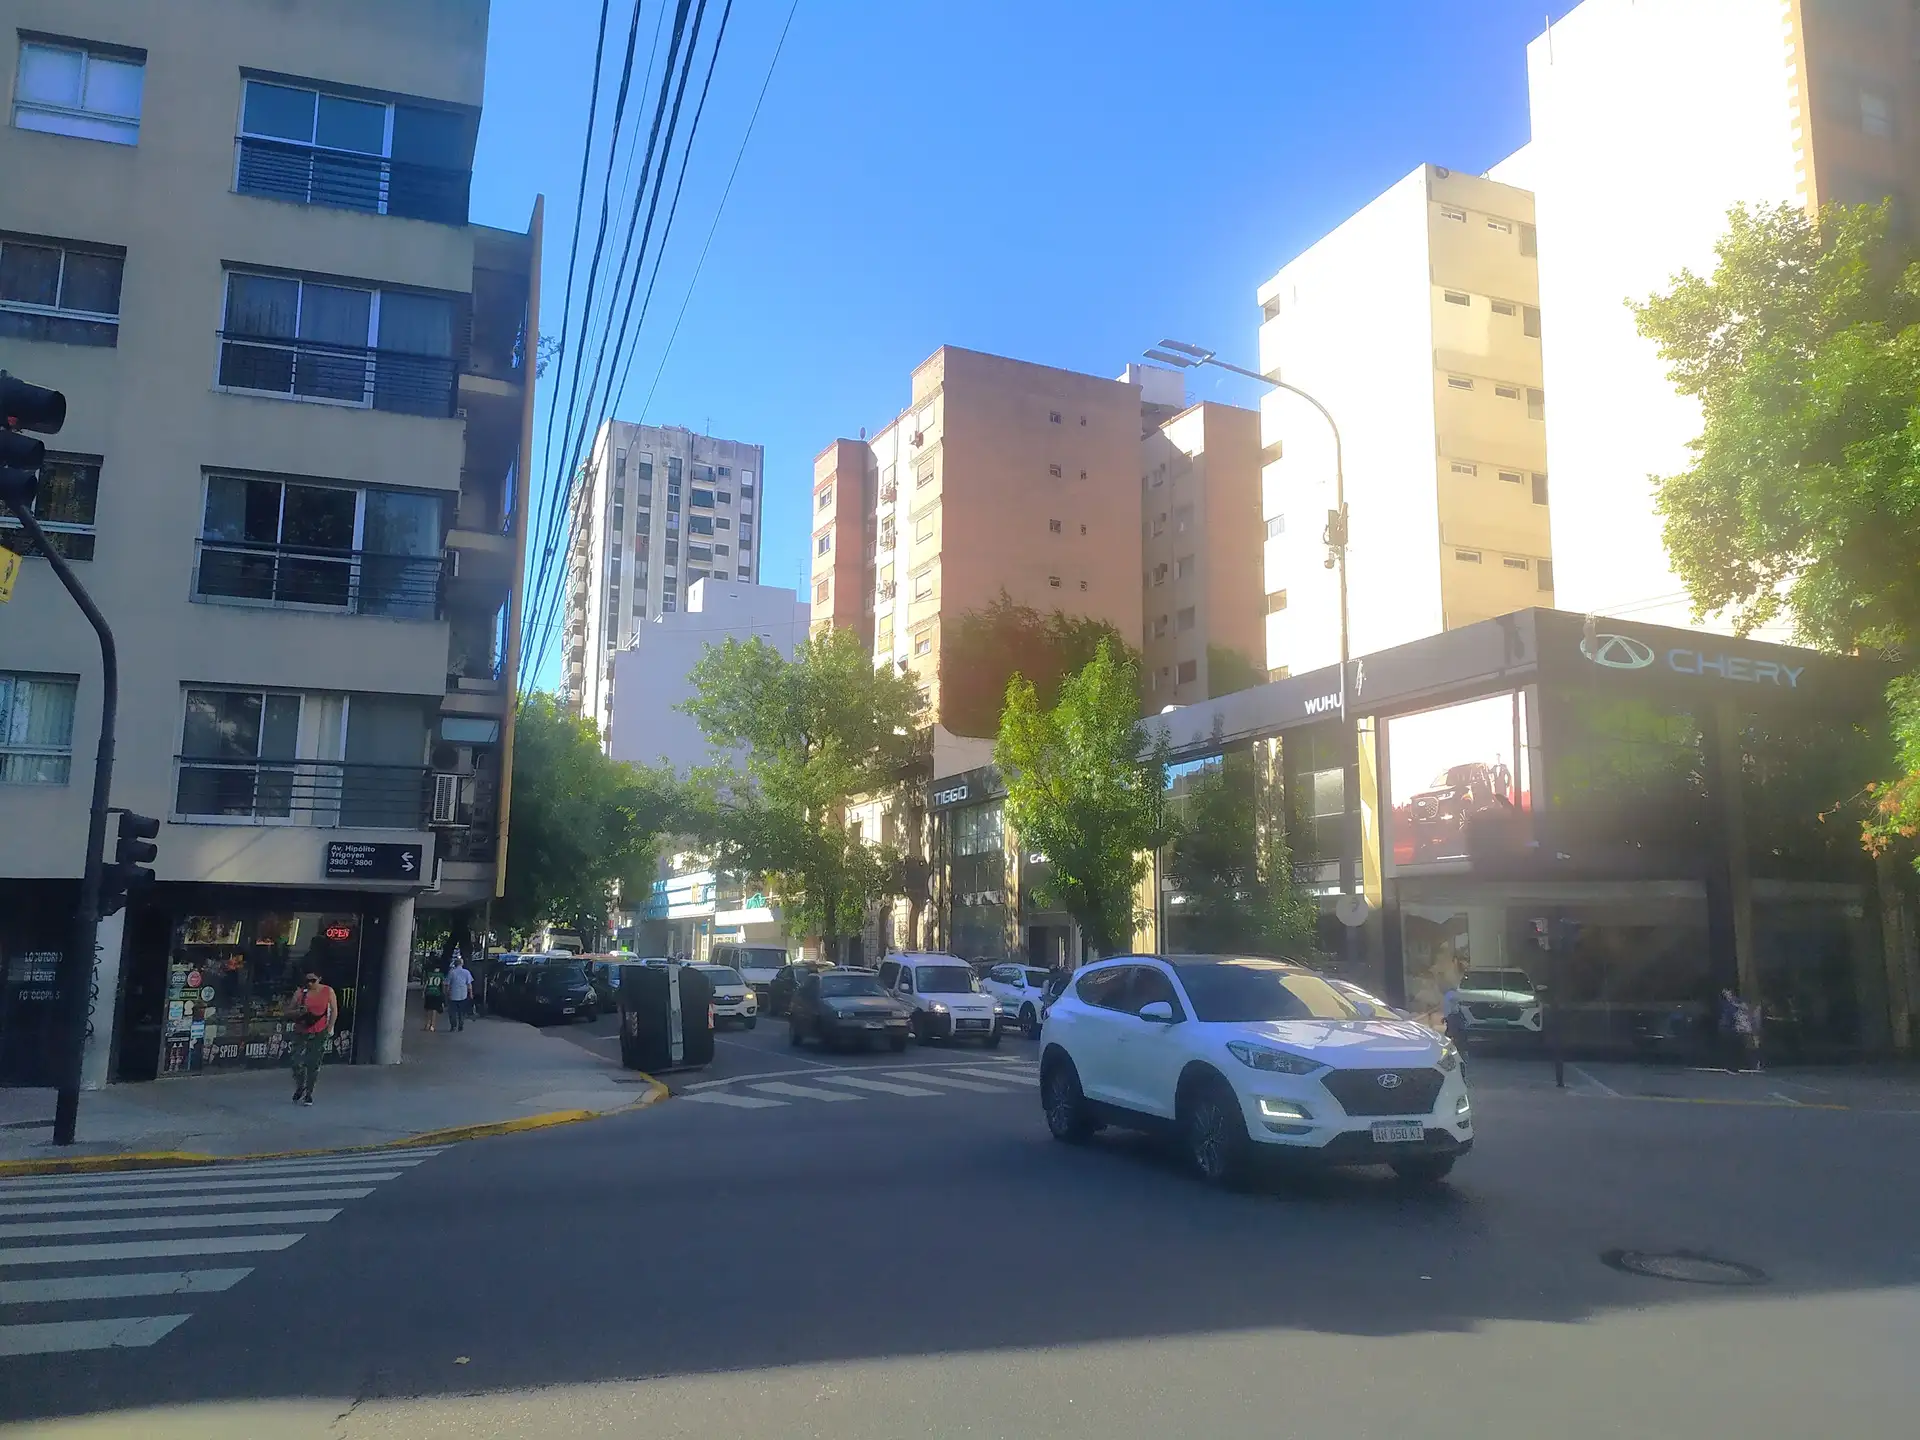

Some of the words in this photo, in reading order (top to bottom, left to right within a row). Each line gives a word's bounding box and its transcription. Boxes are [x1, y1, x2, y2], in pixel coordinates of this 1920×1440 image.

[1668, 648, 1805, 688] CHERY
[1304, 692, 1343, 715] WUHU
[933, 785, 969, 806] TIGGO
[330, 844, 342, 852] Av.
[345, 844, 376, 854] Hipólito
[330, 851, 365, 860] Yrigoyen
[329, 858, 348, 866] 3900
[355, 859, 373, 867] 3800
[326, 928, 350, 938] OPEN
[428, 976, 441, 986] 10
[219, 1044, 238, 1058] SPEED
